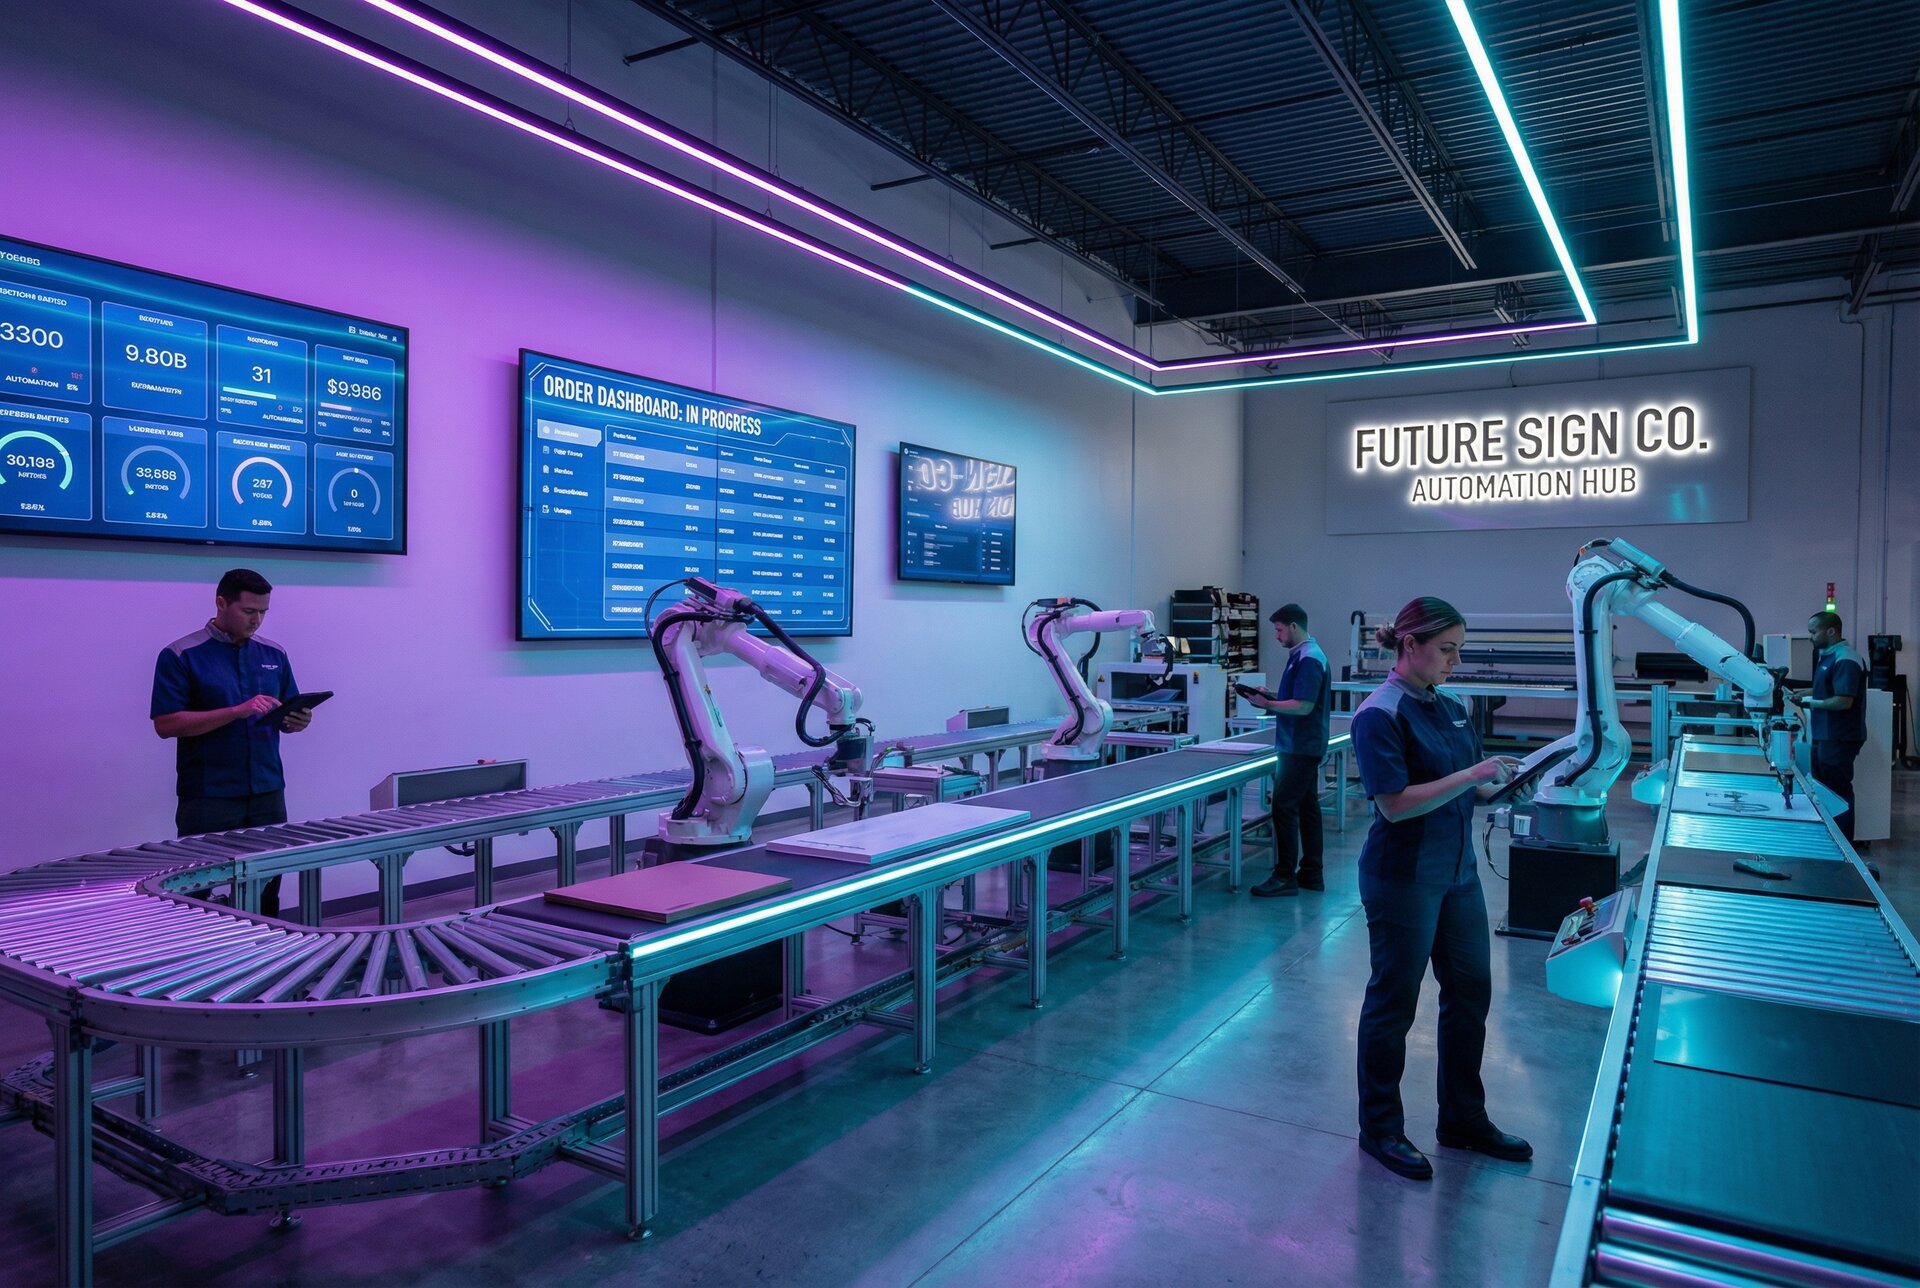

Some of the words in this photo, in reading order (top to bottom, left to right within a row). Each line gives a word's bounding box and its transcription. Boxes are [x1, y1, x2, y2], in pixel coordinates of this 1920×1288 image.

[126, 344, 187, 369] 9.80B
[5, 374, 59, 388] AUTOMATION
[252, 366, 271, 384] 31
[543, 374, 593, 405] ORDER
[597, 385, 683, 422] DASHBOARD:
[685, 404, 699, 425] IN
[702, 407, 762, 436] PROGRESS
[1355, 419, 1503, 469] FUTURE
[1517, 411, 1618, 460] SIGN
[1636, 405, 1709, 453] CO.
[1411, 469, 1572, 502] AUTOMATION
[1582, 467, 1637, 495] HUB
